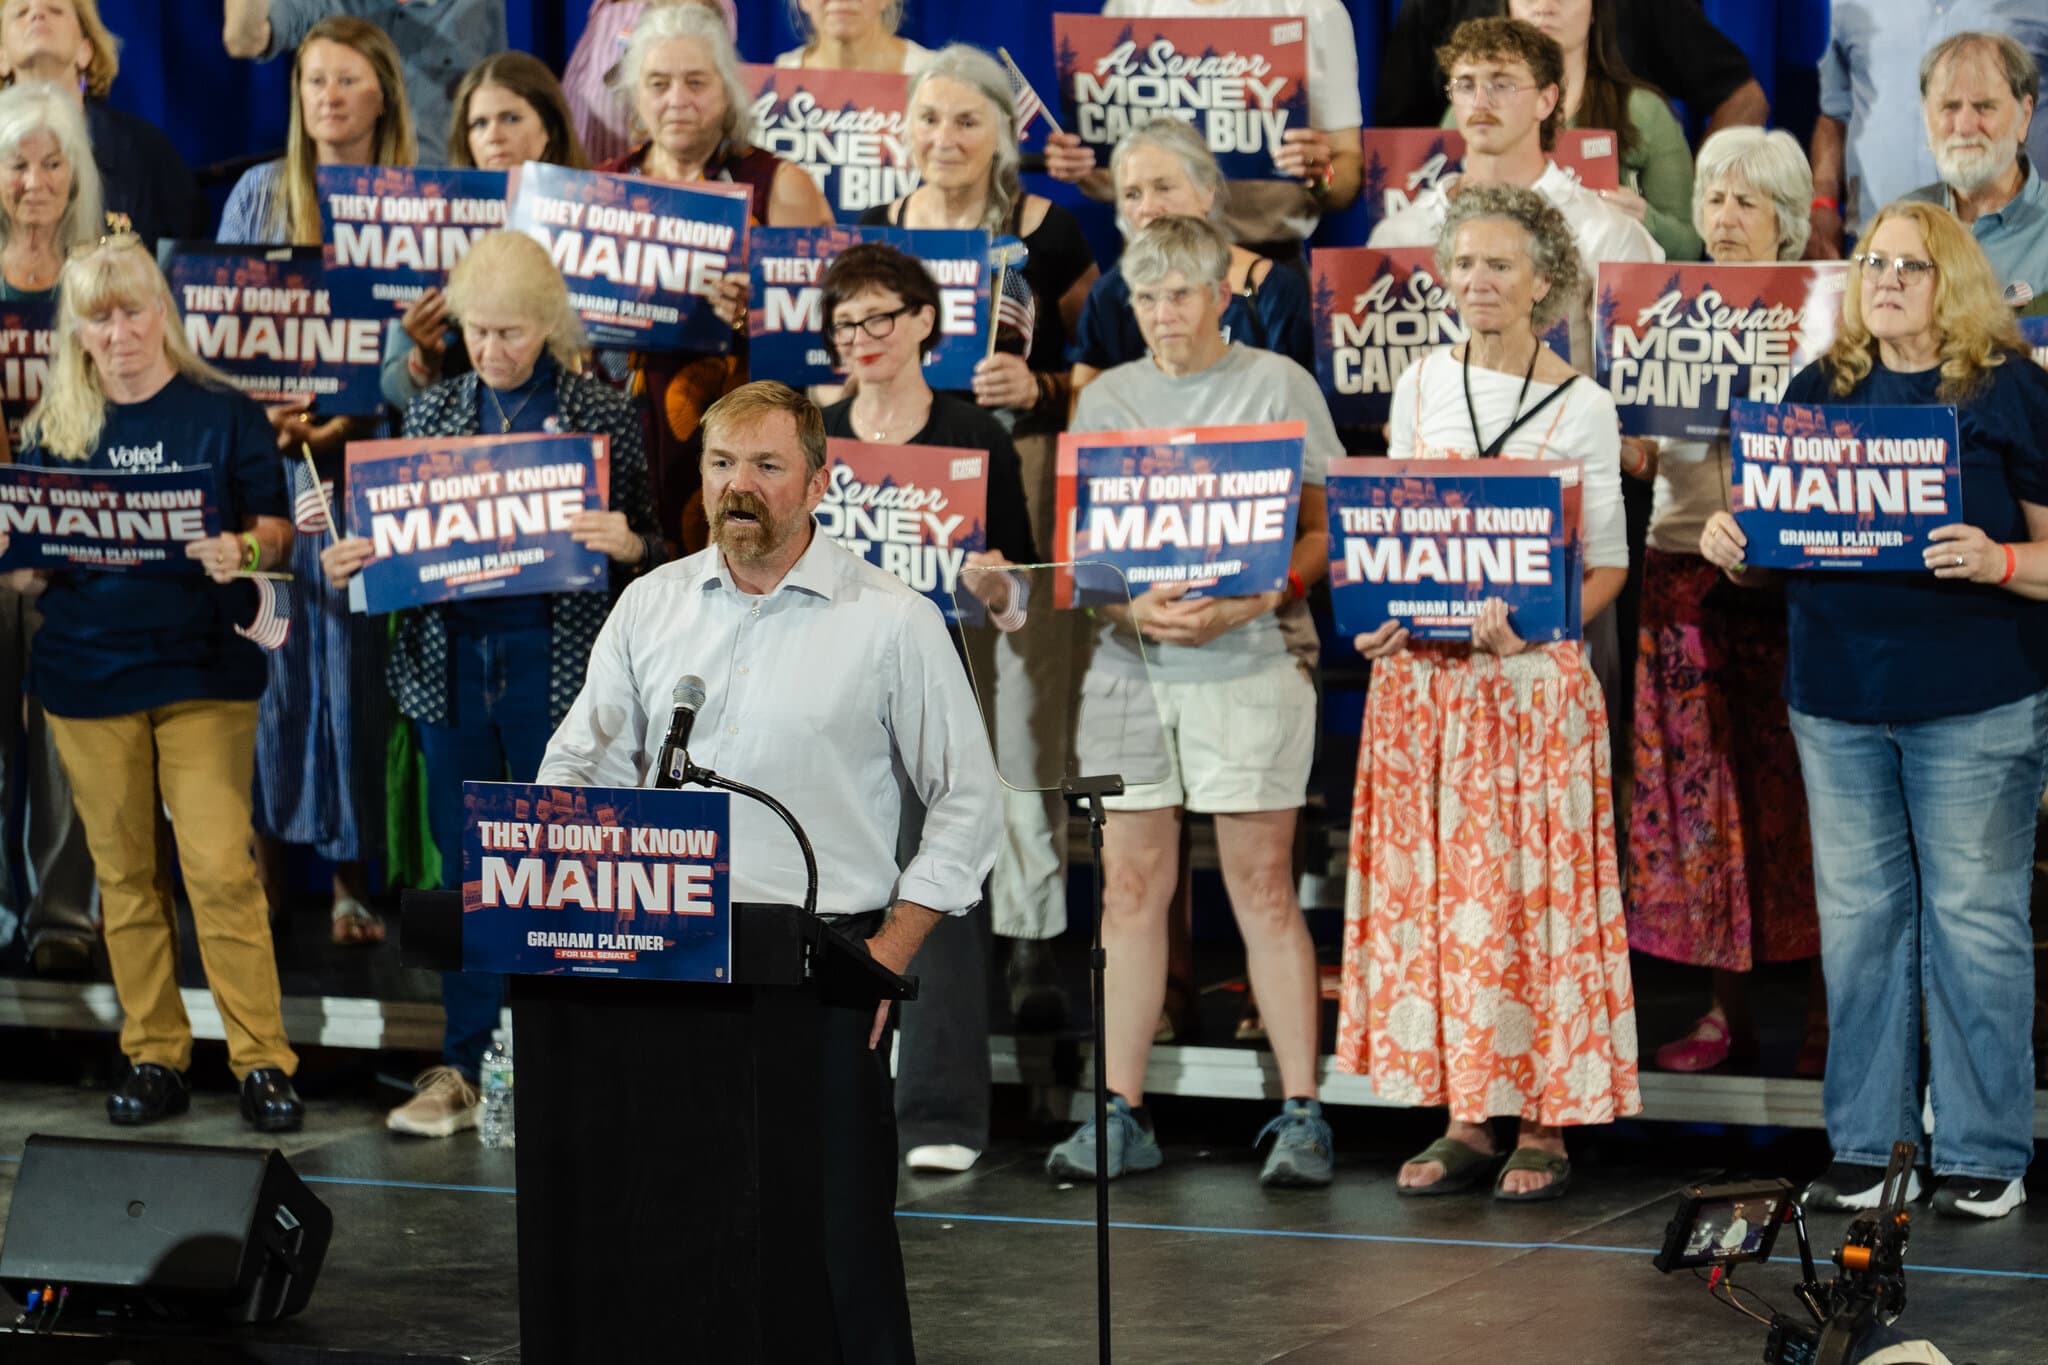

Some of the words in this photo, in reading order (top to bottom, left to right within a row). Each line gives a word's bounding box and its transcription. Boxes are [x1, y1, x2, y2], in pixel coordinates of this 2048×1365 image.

[1095, 40, 1138, 76] A
[1142, 39, 1271, 77] Senator
[1074, 72, 1288, 110] MONEY
[780, 91, 907, 134] Senator
[1206, 109, 1289, 154] BUY
[752, 128, 910, 167] ONEY
[329, 194, 378, 220] THEY
[382, 196, 447, 223] DON'T
[586, 205, 656, 237] DON'T
[658, 216, 733, 250] KNOW
[333, 222, 502, 270] MAIN
[528, 225, 727, 295] MAINE
[762, 257, 820, 283] THEY
[925, 259, 977, 286] OW
[183, 285, 239, 312] THEY
[242, 287, 311, 314] DON'T
[568, 292, 618, 313] RAHAM
[620, 300, 679, 324] PLATNER
[1354, 273, 1397, 314] A
[1637, 290, 1682, 327] A
[184, 314, 380, 363] MAINE
[1332, 311, 1472, 348] MON
[1611, 359, 1738, 411] CAN'T
[108, 441, 163, 469] Voted
[1740, 432, 1789, 461] THEY
[1792, 436, 1860, 463] DON'T
[1866, 438, 1945, 464] KNOW
[0, 484, 43, 506] HEY
[50, 488, 119, 510] DON'T
[126, 489, 202, 510] KNOW
[366, 481, 424, 513] THEY
[429, 472, 501, 503] DON'T
[505, 463, 584, 493] KNOW
[822, 463, 949, 513] Senator
[1089, 476, 1145, 503] THEY
[1150, 472, 1218, 500] DON'T
[1220, 468, 1293, 497] KNOW
[1742, 463, 1946, 513] MAINE
[0, 503, 206, 541] MAINE
[371, 489, 583, 558] MAINE
[813, 503, 965, 547] ONEY
[1089, 497, 1287, 551] MAINE
[1340, 506, 1397, 533] THEY
[1401, 507, 1471, 533] DON'T
[1475, 508, 1551, 534] KNOW
[1780, 529, 1838, 546] GRAHAM
[1842, 530, 1903, 547] PLATNER
[419, 556, 480, 583] GRAHAM
[483, 548, 544, 570] PLATNER
[882, 542, 965, 593] BUY
[1127, 564, 1186, 583] GRAHAM
[1189, 559, 1241, 580] PLATNER
[1344, 537, 1551, 584] MAINE
[1388, 600, 1447, 616] GRAHAM
[1451, 600, 1508, 616] PLAT
[478, 821, 541, 850] THEY
[548, 824, 625, 853] DON'T
[631, 827, 716, 857] KNOW
[482, 856, 714, 914] MAINE
[528, 931, 593, 949] GRAHAM
[598, 934, 664, 951] PLATNER
[562, 950, 578, 958] FOR
[597, 951, 630, 960] SENATE
